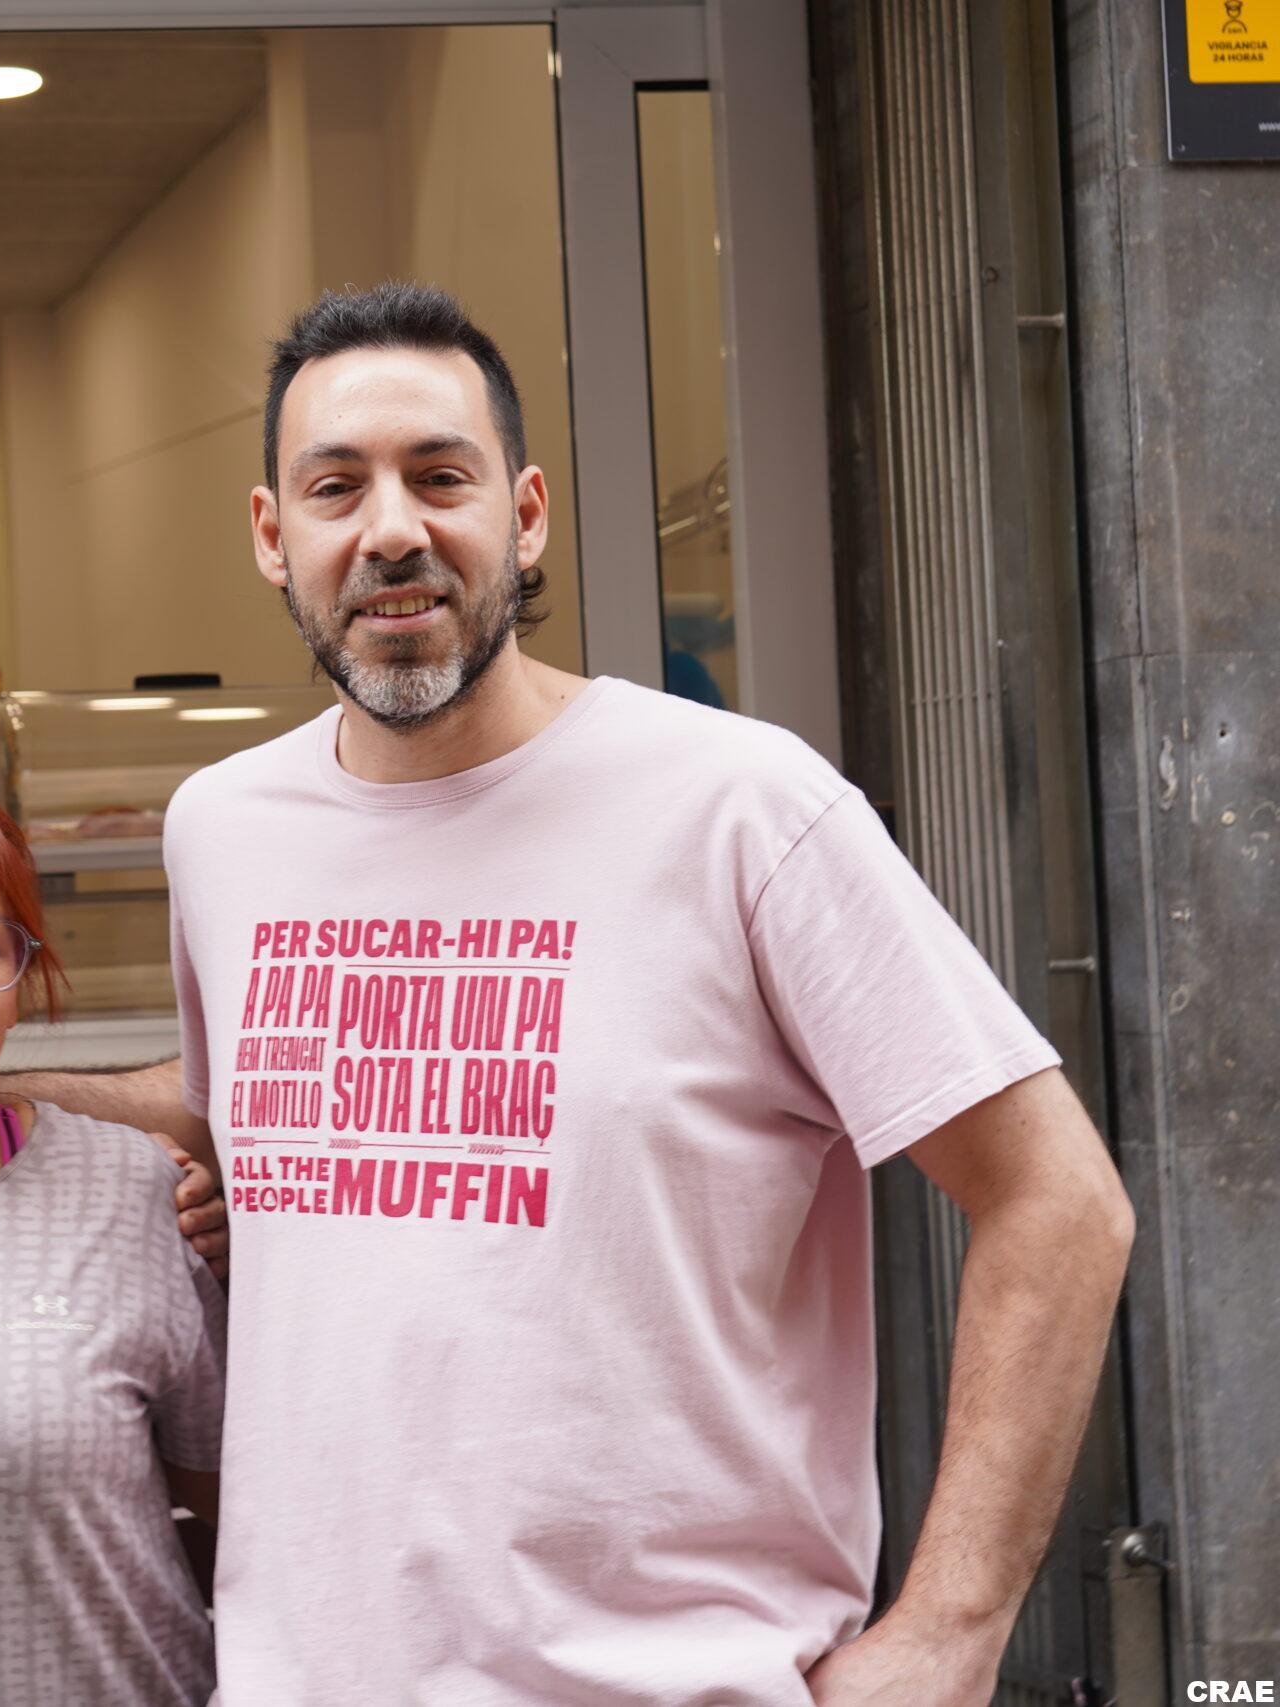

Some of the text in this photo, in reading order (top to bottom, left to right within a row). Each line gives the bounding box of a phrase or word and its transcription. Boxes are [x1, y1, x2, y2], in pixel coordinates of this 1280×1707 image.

[1208, 41, 1268, 51] VIGILANCIA
[1213, 53, 1264, 63] 24 HORAS
[252, 918, 578, 961] PER SUCAR-HI PA!
[240, 964, 335, 1030] A PA PA
[336, 973, 565, 1054] PORTA UN PA
[263, 1036, 327, 1072] TRENCAT
[231, 1080, 322, 1128] EL MOTLLO
[331, 1055, 557, 1147] SOTA EL BRAÇ
[231, 1155, 331, 1182] ALL THE
[232, 1186, 328, 1215] PEOPLE
[331, 1157, 549, 1228] MUFFIN
